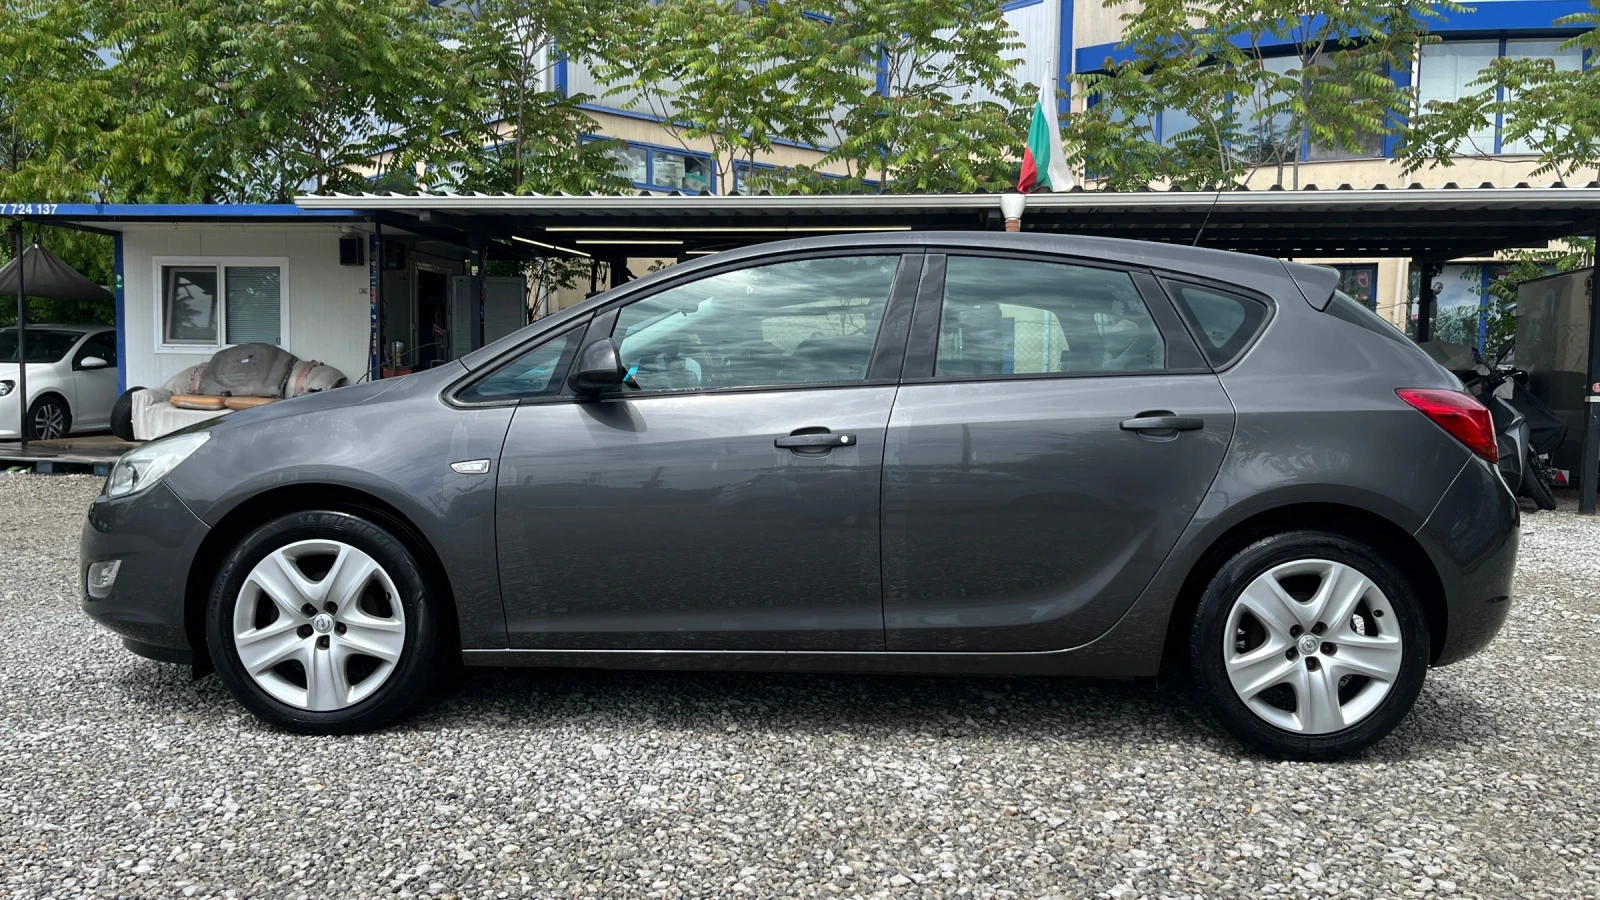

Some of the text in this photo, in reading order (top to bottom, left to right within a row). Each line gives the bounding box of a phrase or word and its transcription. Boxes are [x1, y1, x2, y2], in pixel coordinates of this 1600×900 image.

[11, 204, 32, 214] 724
[37, 204, 58, 214] 137
[319, 514, 403, 556] MICHELIN
